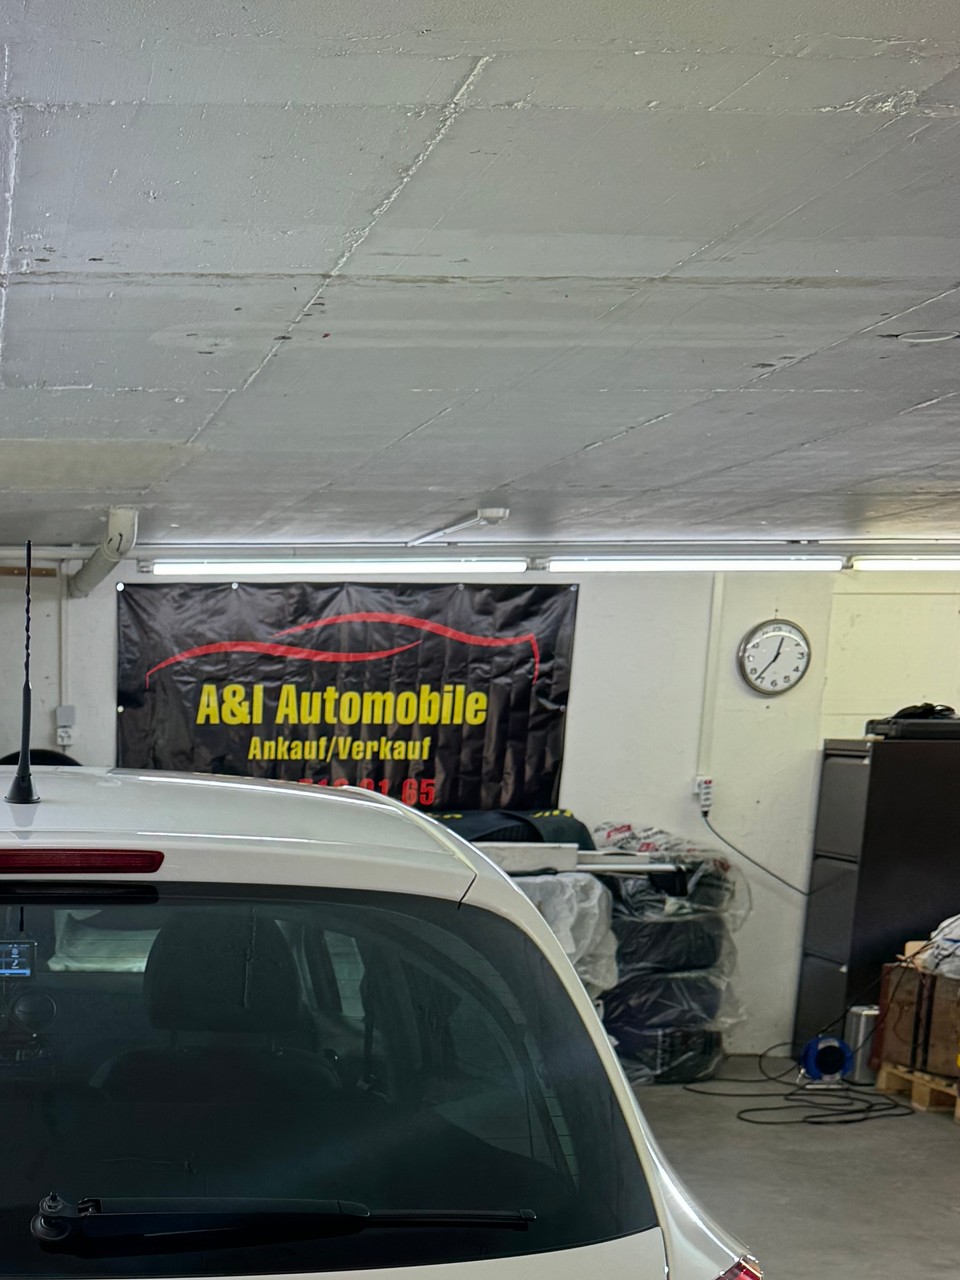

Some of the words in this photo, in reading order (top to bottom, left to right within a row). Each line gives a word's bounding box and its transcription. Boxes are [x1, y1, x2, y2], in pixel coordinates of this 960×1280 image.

[196, 684, 264, 725] A&I
[275, 684, 488, 725] Automobile
[247, 736, 432, 764] Ankauf/Verkauf
[401, 777, 437, 806] 65
